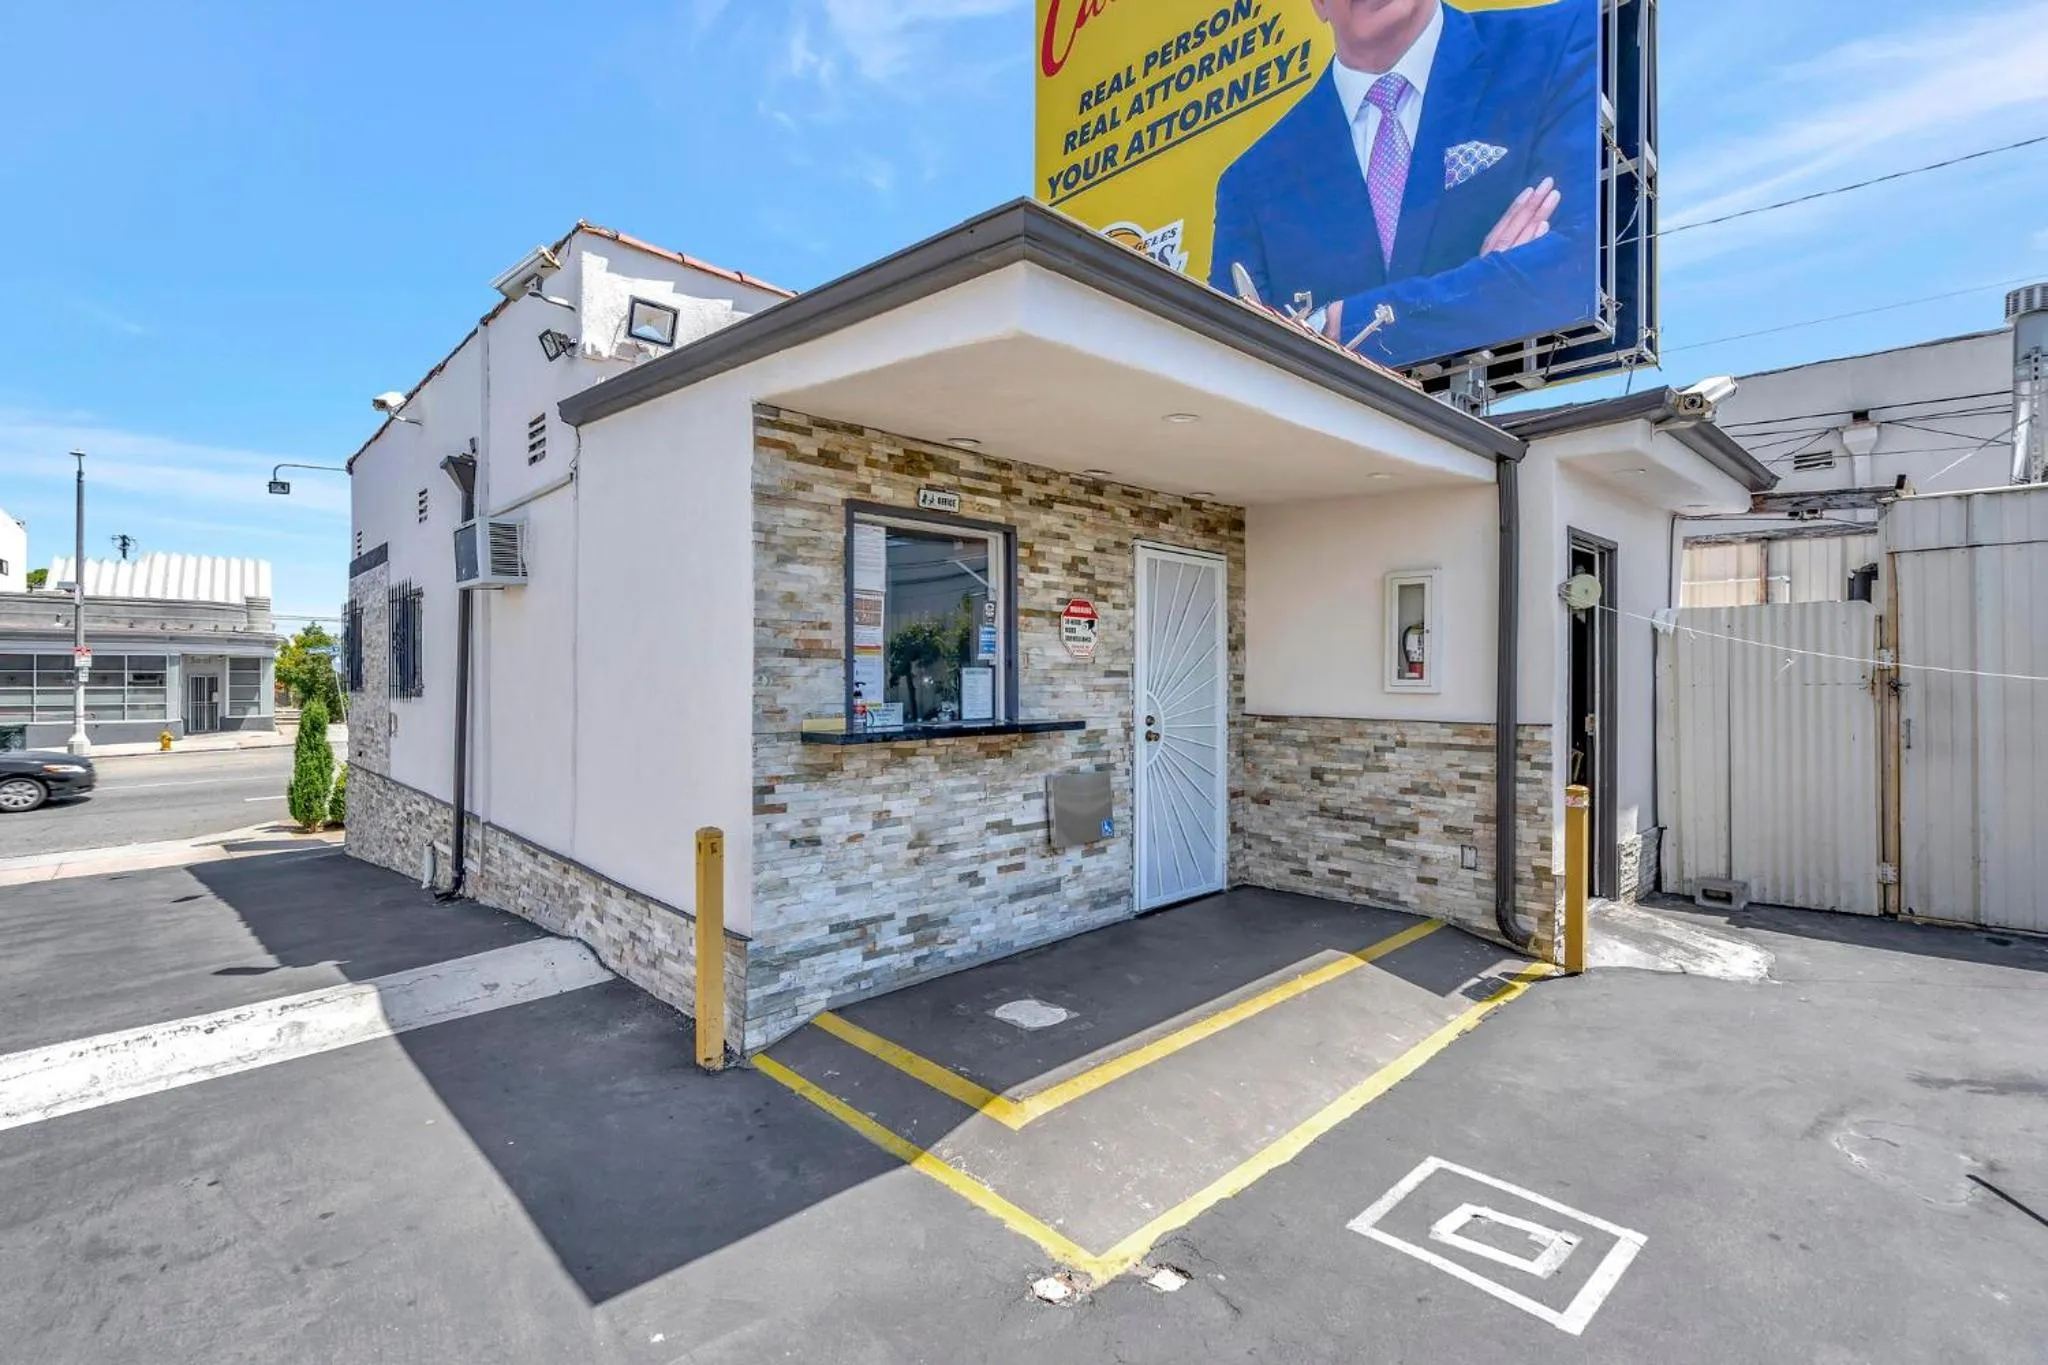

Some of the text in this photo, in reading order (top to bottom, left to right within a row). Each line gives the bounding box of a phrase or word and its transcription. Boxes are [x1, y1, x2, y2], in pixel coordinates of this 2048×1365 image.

[1047, 143, 1119, 200] YOUR
[1123, 38, 1312, 162] ATTORNEY!
[1063, 105, 1121, 156] REAL
[1125, 12, 1285, 122] ATTORNEY,
[1078, 64, 1136, 115] REAL
[1142, 0, 1262, 79] PERSON,
